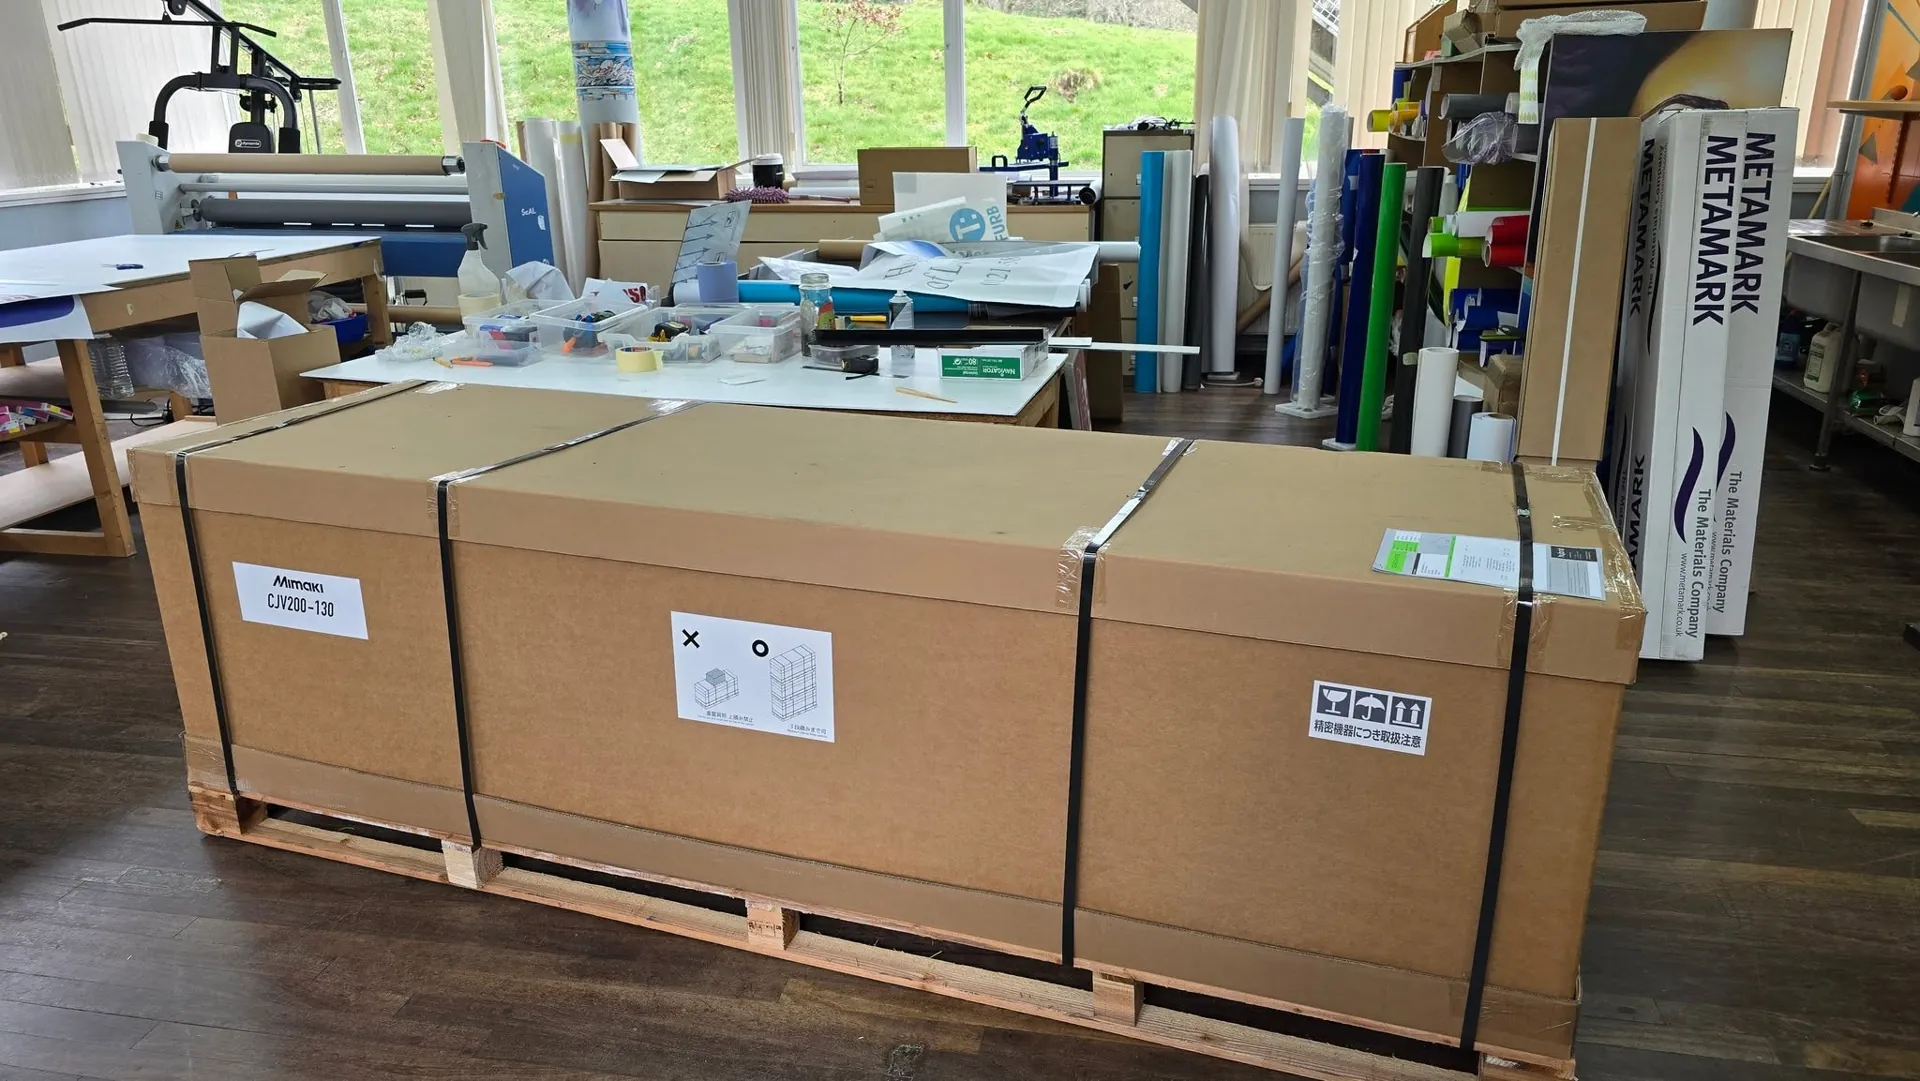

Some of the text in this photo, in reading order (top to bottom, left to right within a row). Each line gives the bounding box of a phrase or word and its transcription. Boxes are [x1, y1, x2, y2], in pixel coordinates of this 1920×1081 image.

[1629, 138, 1656, 317] METAMARK
[1692, 135, 1738, 326] METAMARK
[1730, 132, 1776, 315] METAMARK
[1627, 454, 1645, 572] AMARK
[1684, 488, 1712, 639] The Materials Company
[1712, 471, 1743, 614] The Materials Company
[267, 593, 334, 617] CJV200-130
[273, 575, 324, 594] Mimaki
[1675, 553, 1688, 638] www.metamark.co.uk
[1313, 719, 1422, 748] 精密機器につき取扱注意
